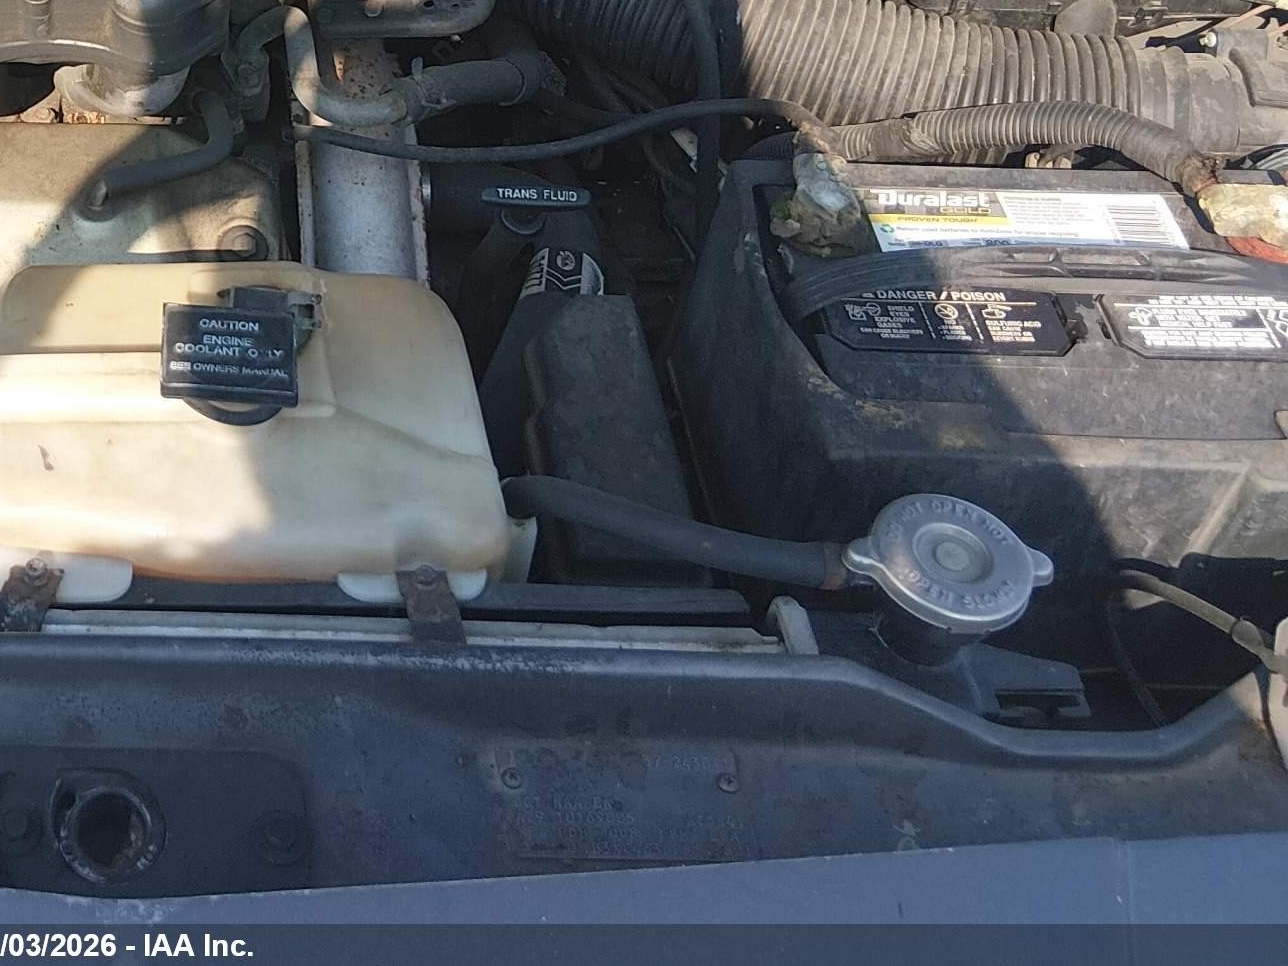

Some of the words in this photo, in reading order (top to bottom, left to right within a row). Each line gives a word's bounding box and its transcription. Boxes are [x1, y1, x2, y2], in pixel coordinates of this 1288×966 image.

[497, 188, 538, 200] TRANS
[543, 189, 578, 202] FLUID
[870, 188, 992, 207] Duralast
[876, 290, 937, 300] DANGER
[951, 291, 1007, 302] POISON
[199, 318, 260, 331] CAUTION
[203, 335, 253, 347] ENGINE
[175, 342, 241, 357] COOLANT
[247, 349, 284, 358] OLY
[170, 361, 192, 371] SEE
[193, 362, 239, 373] OWNERS
